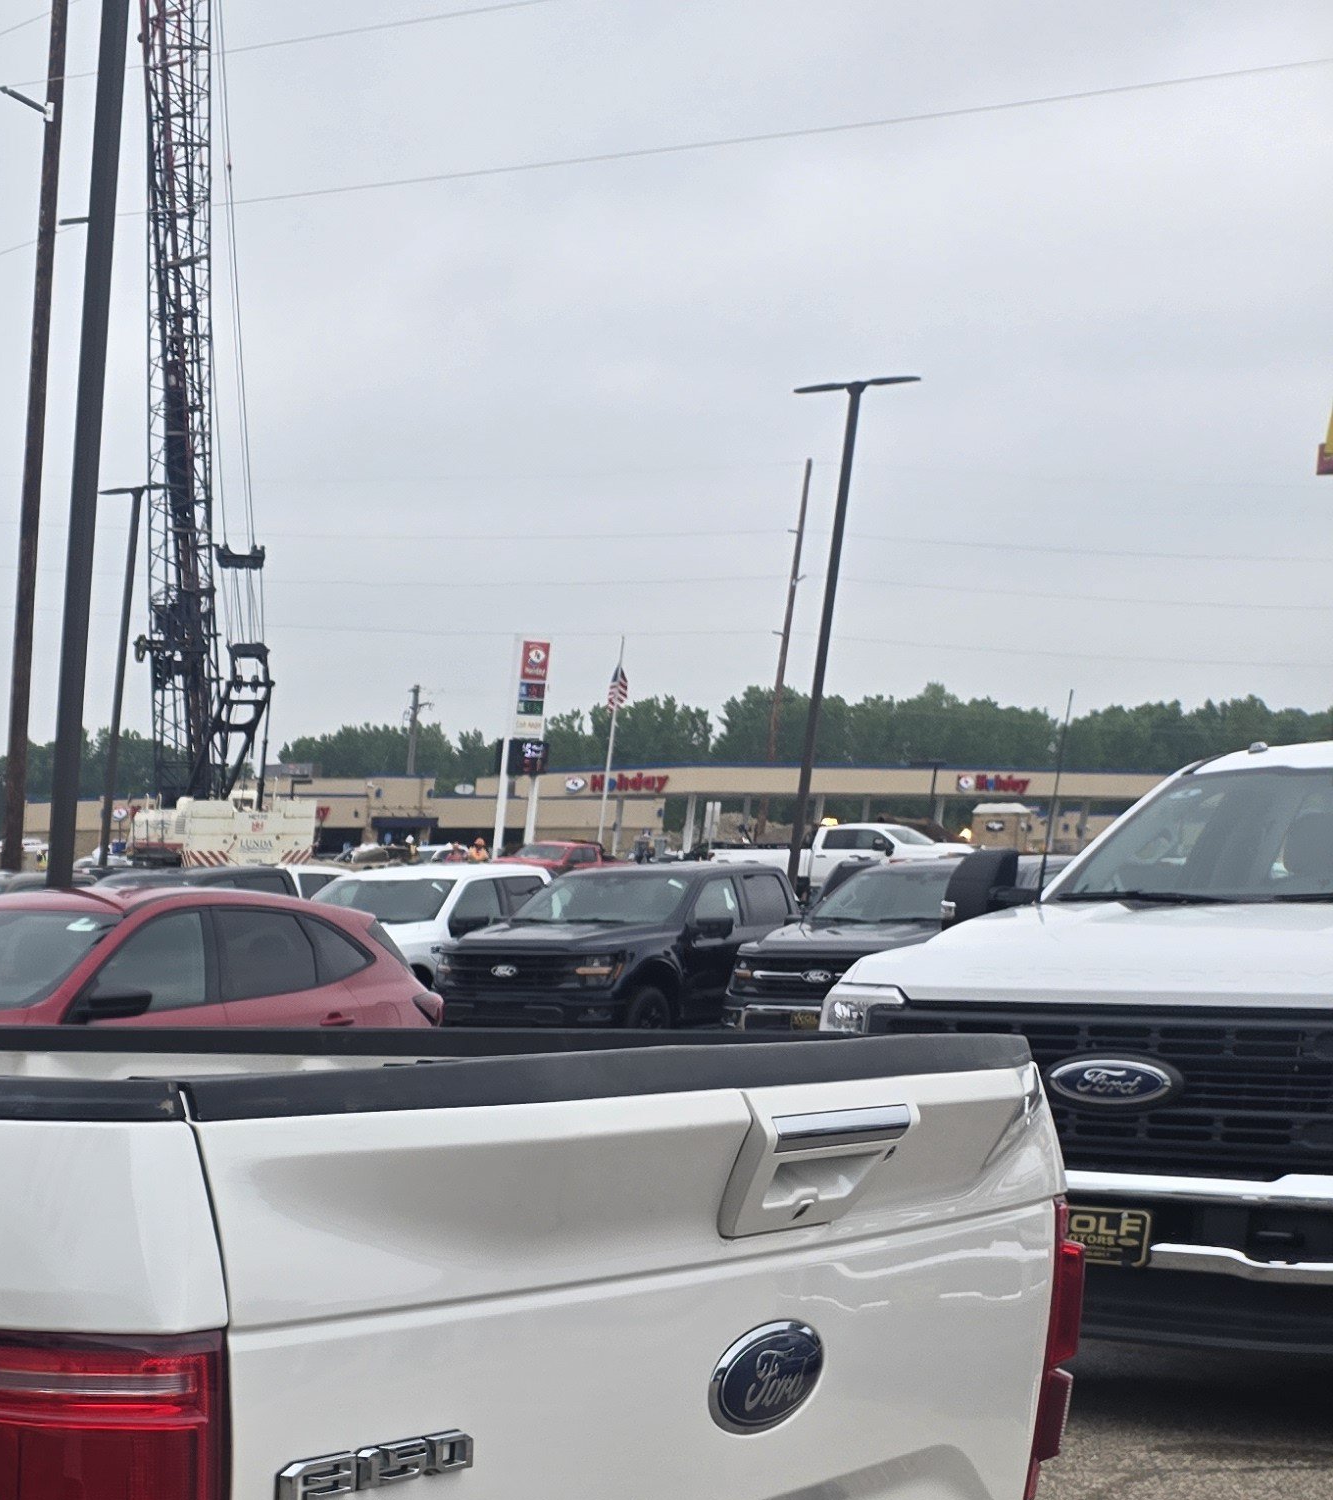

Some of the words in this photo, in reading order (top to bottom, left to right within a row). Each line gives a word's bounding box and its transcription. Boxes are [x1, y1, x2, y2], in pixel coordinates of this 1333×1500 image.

[1076, 1068, 1142, 1094] Ford
[1070, 1214, 1142, 1236] OLF
[1068, 1232, 1115, 1247] OTORS
[744, 1347, 807, 1412] Ford
